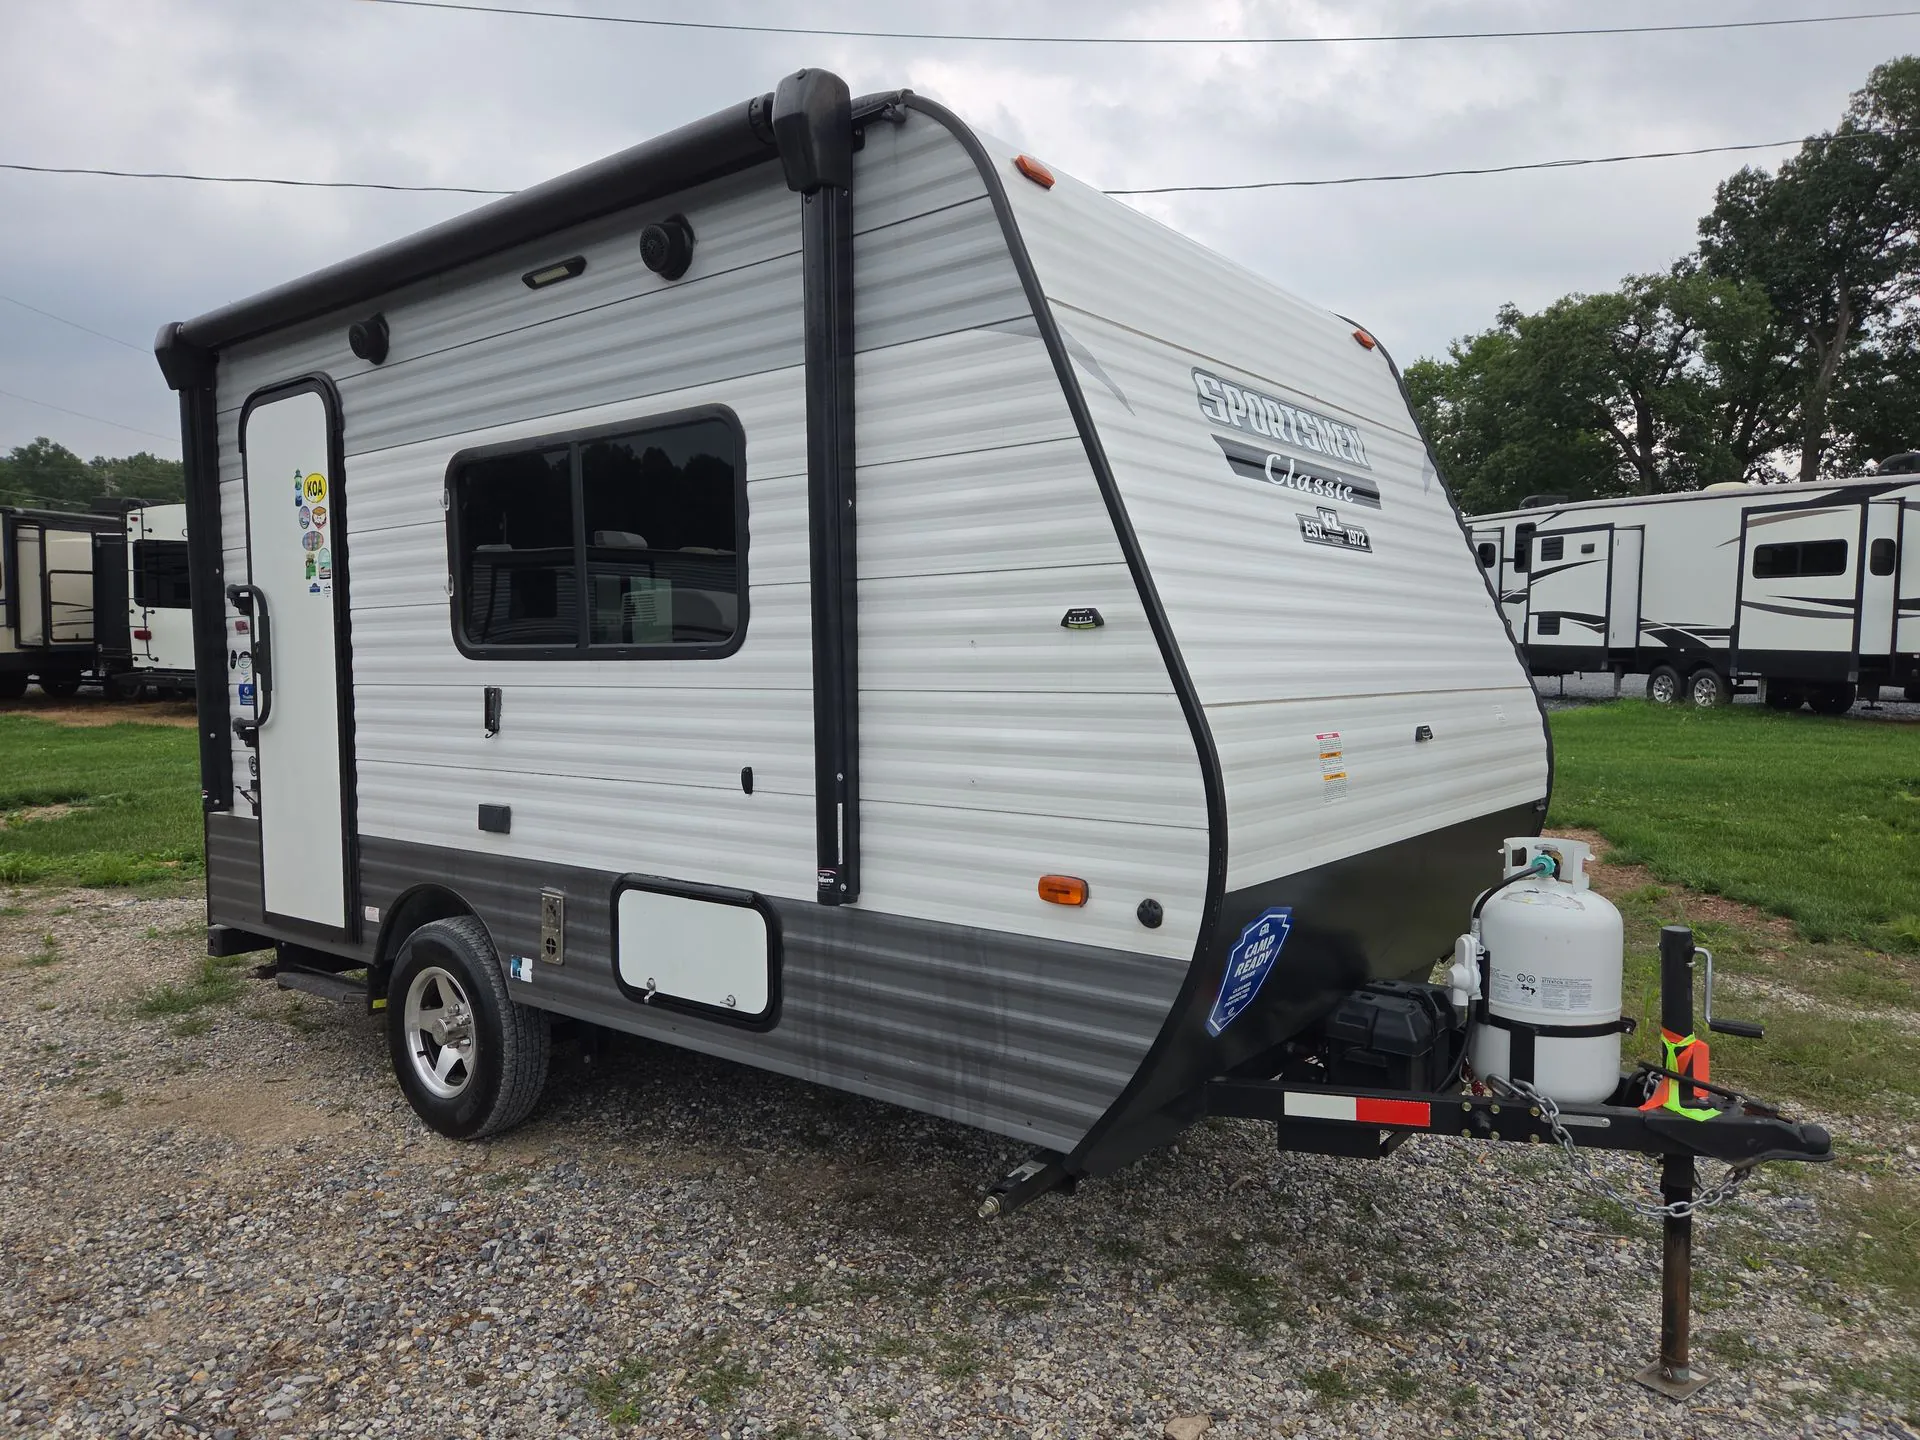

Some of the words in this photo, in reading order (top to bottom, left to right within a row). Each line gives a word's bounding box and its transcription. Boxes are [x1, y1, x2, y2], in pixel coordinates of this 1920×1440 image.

[1194, 372, 1370, 467] SPORTSMEN
[307, 480, 323, 497] KOA
[1265, 453, 1354, 503] Classic
[1304, 520, 1326, 540] EST.
[1346, 529, 1367, 547] 1972
[1244, 934, 1276, 960] CAMP
[1234, 949, 1273, 978] READY
